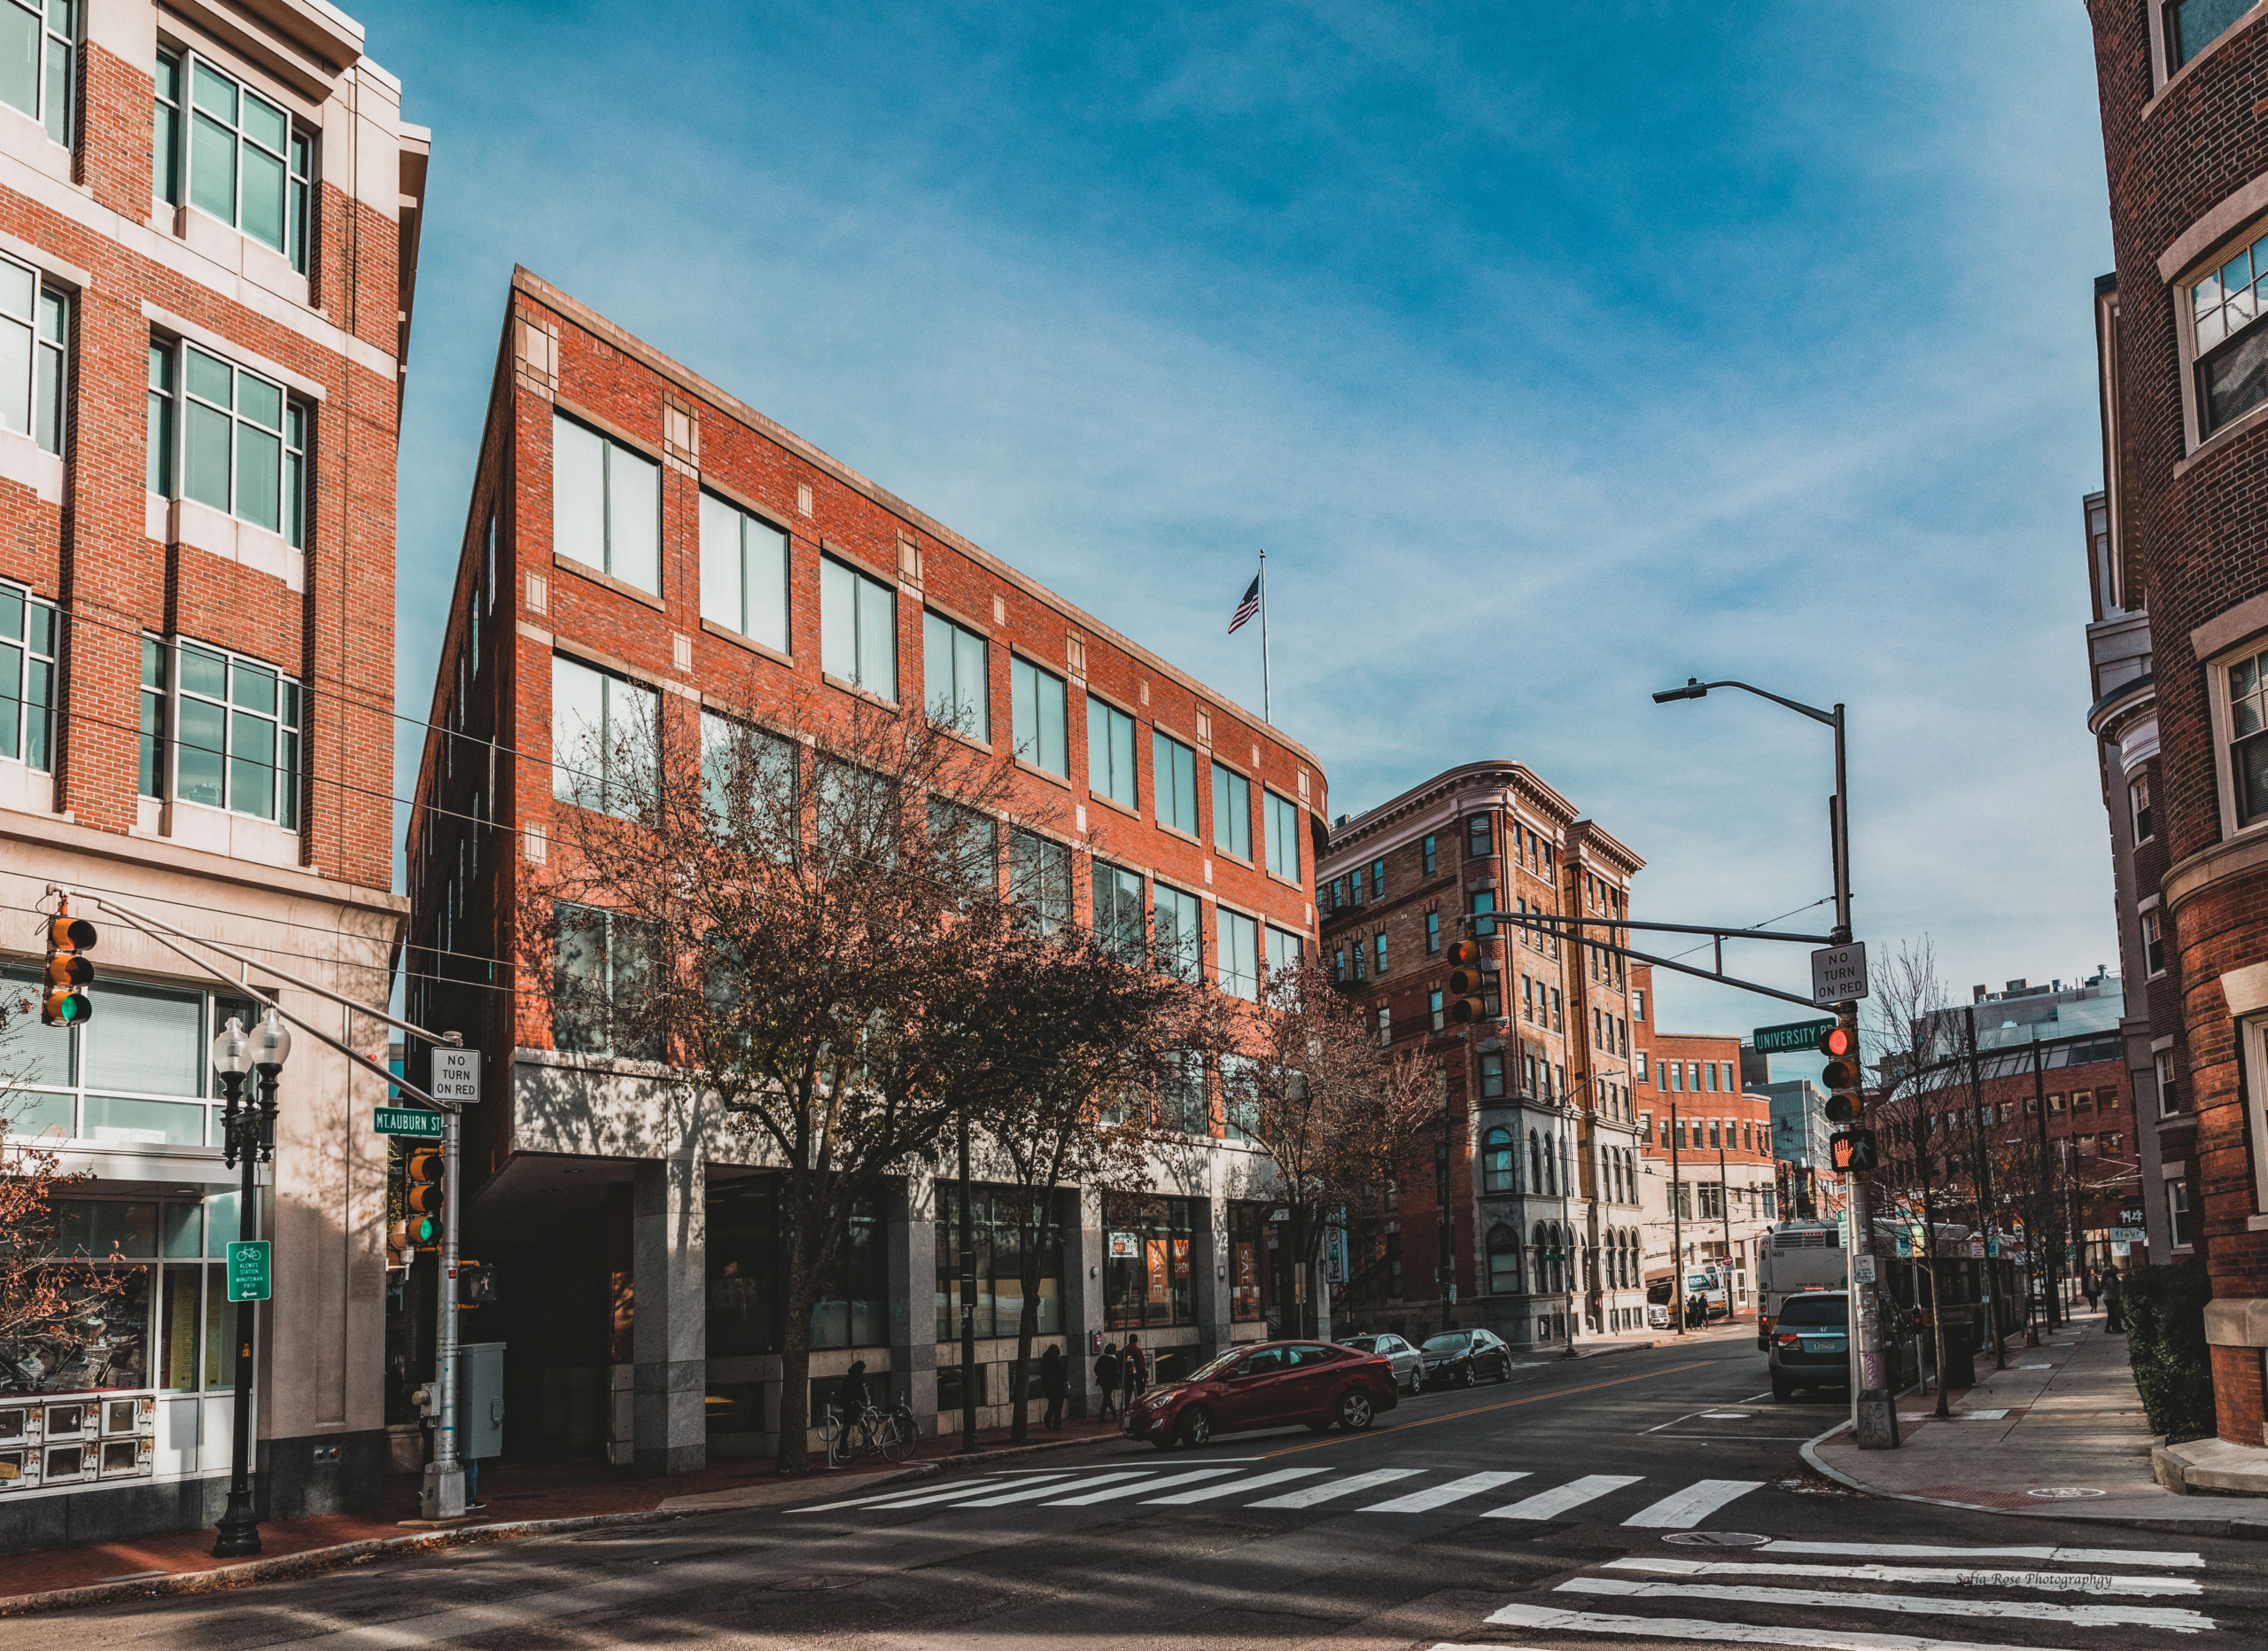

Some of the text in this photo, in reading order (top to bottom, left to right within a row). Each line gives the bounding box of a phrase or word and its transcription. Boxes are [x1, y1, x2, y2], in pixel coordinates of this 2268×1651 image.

[1829, 952, 1848, 965] NO
[1823, 966, 1855, 981] TURN
[1819, 981, 1862, 998] ON RED
[1756, 1026, 1816, 1049] UNIVERSITY
[447, 1055, 465, 1066] NO
[443, 1070, 470, 1081] TURN
[437, 1084, 476, 1095] ON RED
[431, 1117, 440, 1132] ST
[1175, 1263, 1190, 1273] OPEN
[1329, 1242, 1340, 1280] FedEx
[1152, 1248, 1162, 1294] SALE
[1240, 1250, 1249, 1295] SALE
